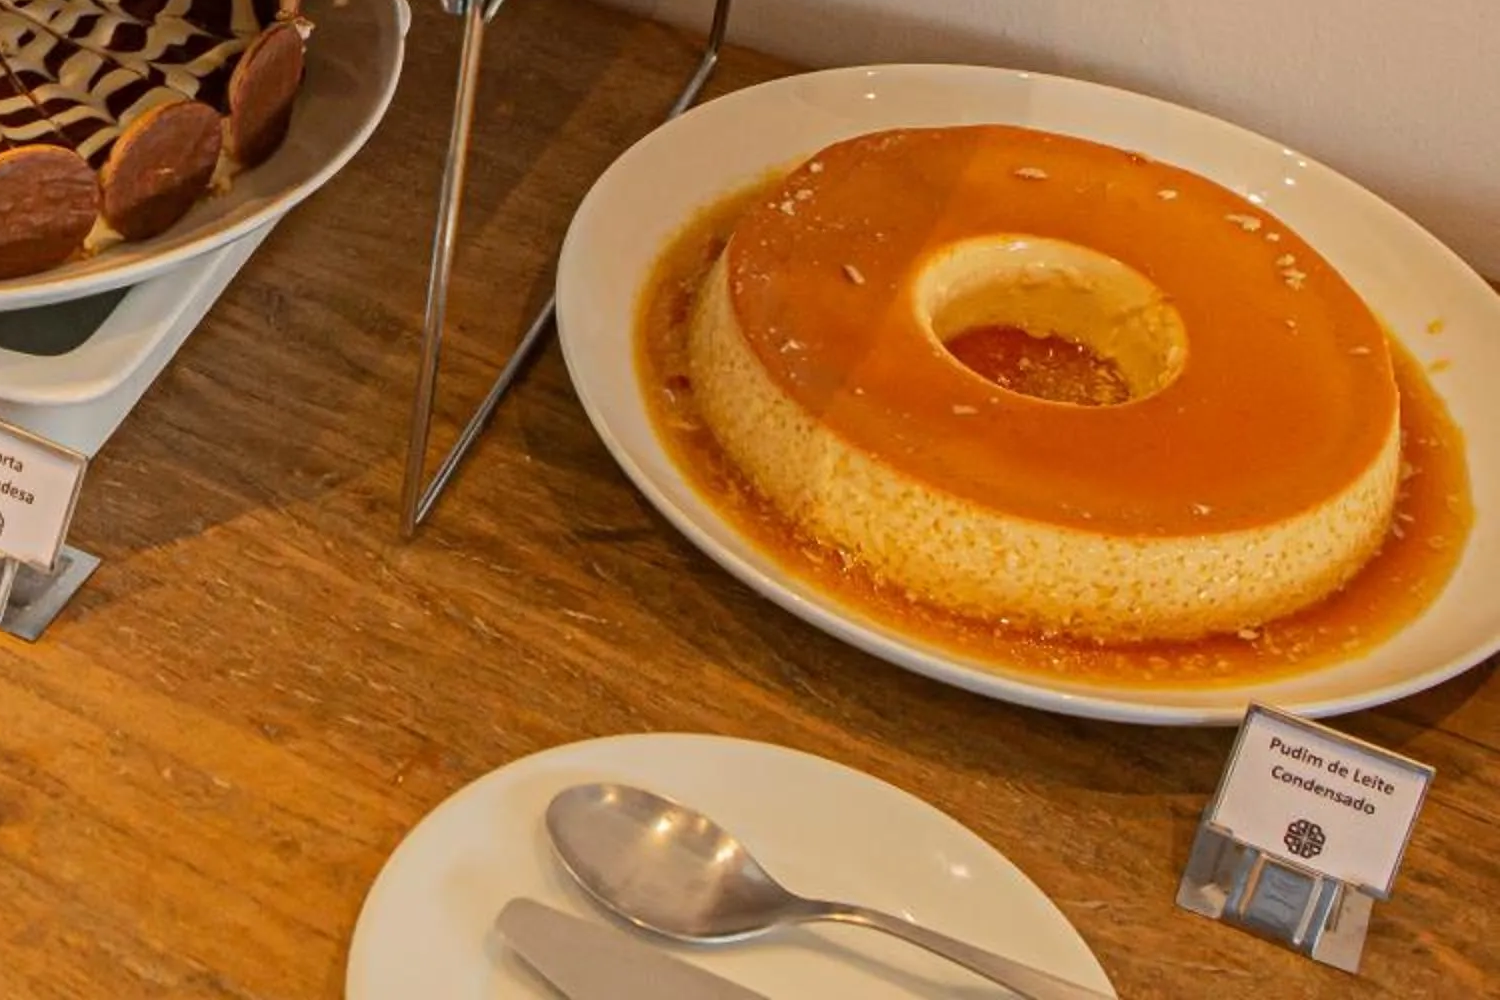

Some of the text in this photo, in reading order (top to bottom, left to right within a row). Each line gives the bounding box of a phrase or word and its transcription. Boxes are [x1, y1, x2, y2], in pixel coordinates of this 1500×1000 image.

[1269, 735, 1396, 797] Pudim de Leite
[1270, 764, 1376, 816] Condensado
